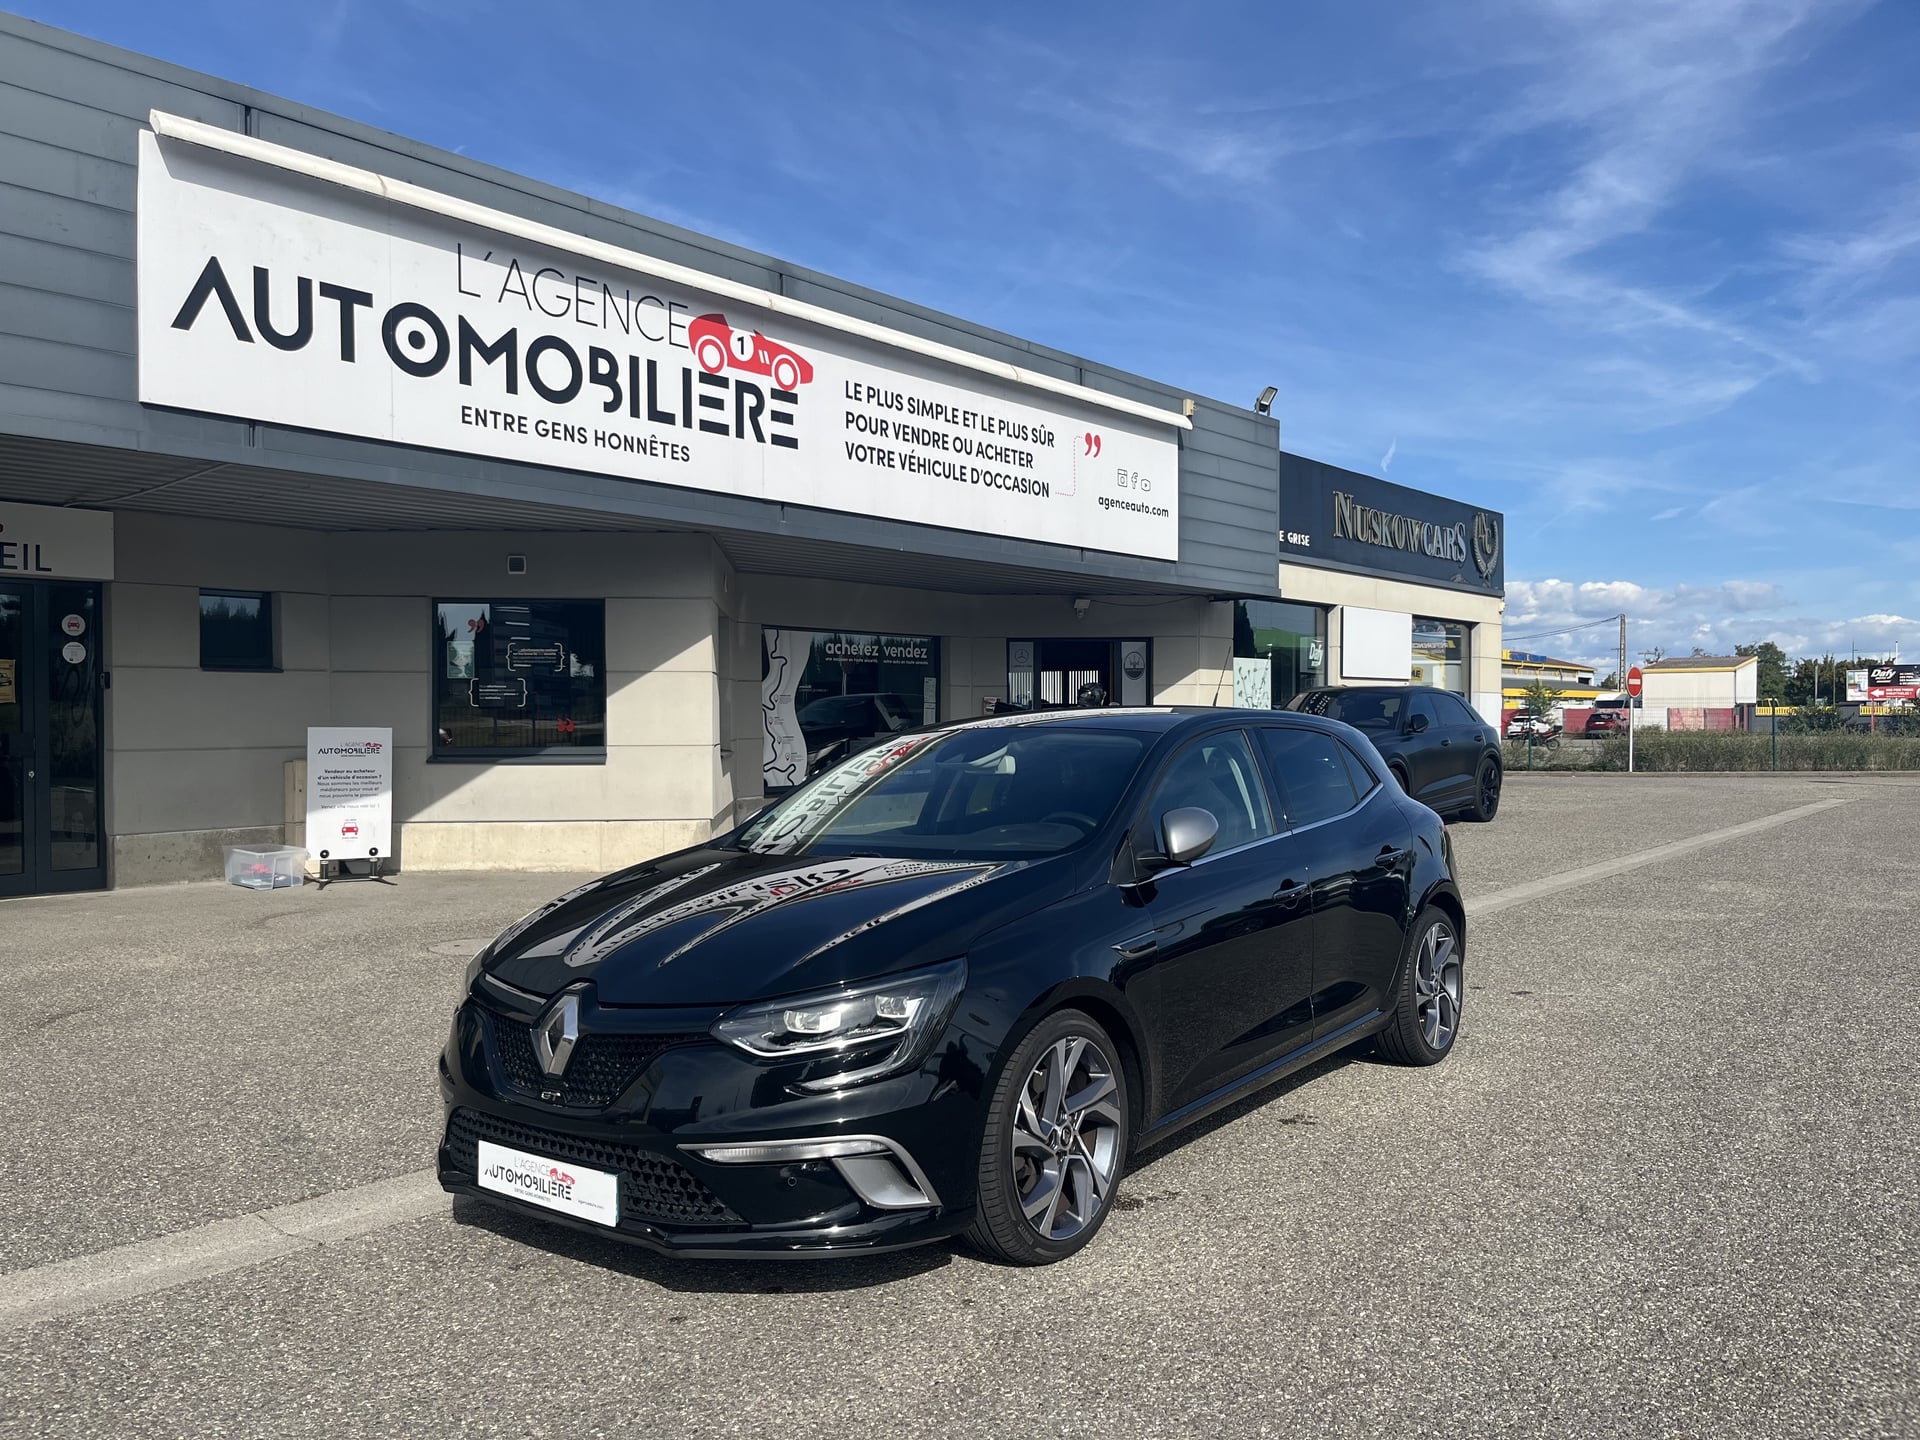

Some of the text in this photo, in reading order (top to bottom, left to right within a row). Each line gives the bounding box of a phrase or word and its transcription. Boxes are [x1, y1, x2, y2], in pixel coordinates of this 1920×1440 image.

[455, 242, 689, 349] L'AGENCE
[170, 255, 799, 450] AUTOMOBILIERE
[461, 405, 691, 463] ENTRE GENS HONNÊTES
[845, 380, 1055, 449] LE PLUS SIMPLE ET LE PLUS SÛR
[845, 411, 1034, 469] POUR VENDRE OU ACHETER
[845, 441, 1050, 498] VOTRE VÉHICULE D'OCCASION
[1098, 495, 1170, 518] agenceauto.com
[0, 541, 52, 572] EIL
[1287, 532, 1311, 547] GRISE
[825, 640, 928, 659] achetez vendez
[1871, 669, 1896, 679] Dafy
